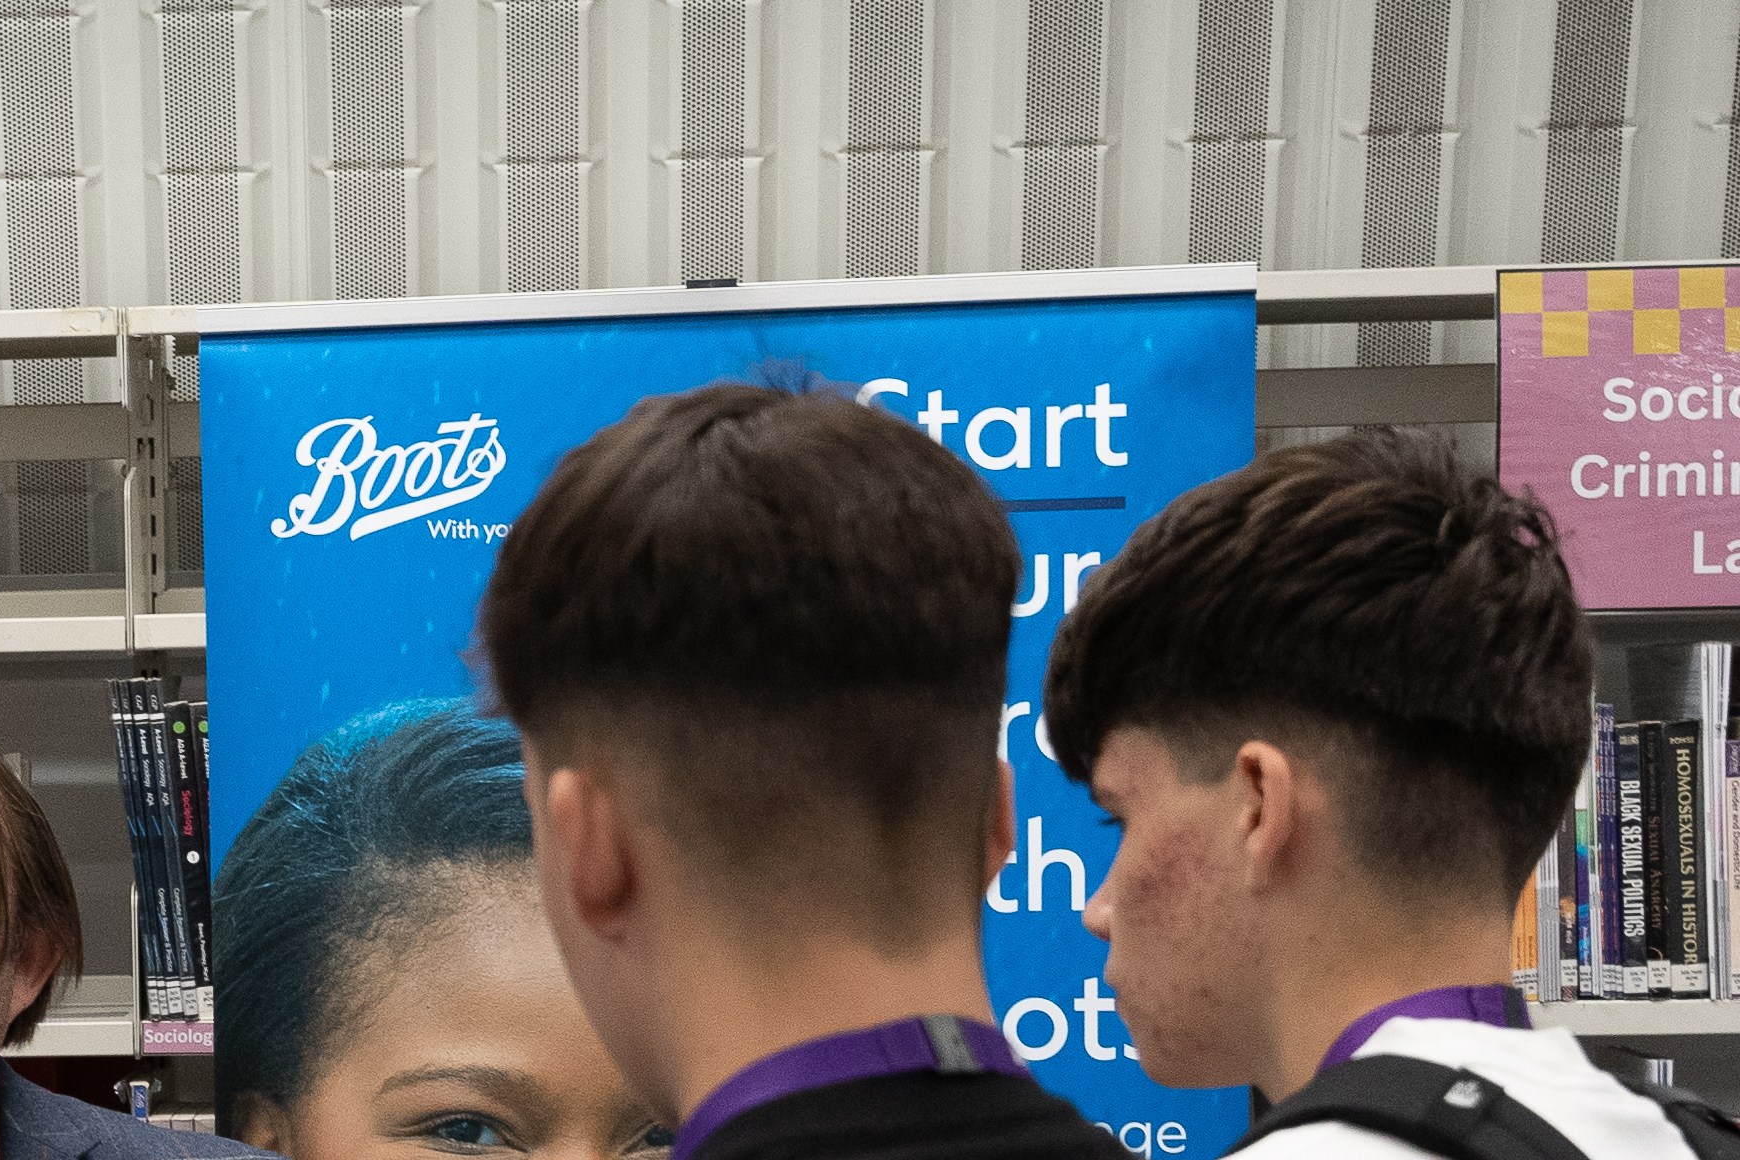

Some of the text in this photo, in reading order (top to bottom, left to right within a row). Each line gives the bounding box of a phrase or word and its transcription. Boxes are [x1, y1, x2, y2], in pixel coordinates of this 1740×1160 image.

[271, 413, 506, 541] Boots
[427, 519, 513, 544] With yo
[135, 695, 144, 711] CGP
[150, 695, 158, 711] CGP
[181, 790, 194, 836] Sociology
[1620, 780, 1645, 937] BLACK SEXUAL POLITICS
[1676, 749, 1698, 964] HOMOSEXUALS IN HISTOR
[144, 1028, 213, 1046] Sociolog
